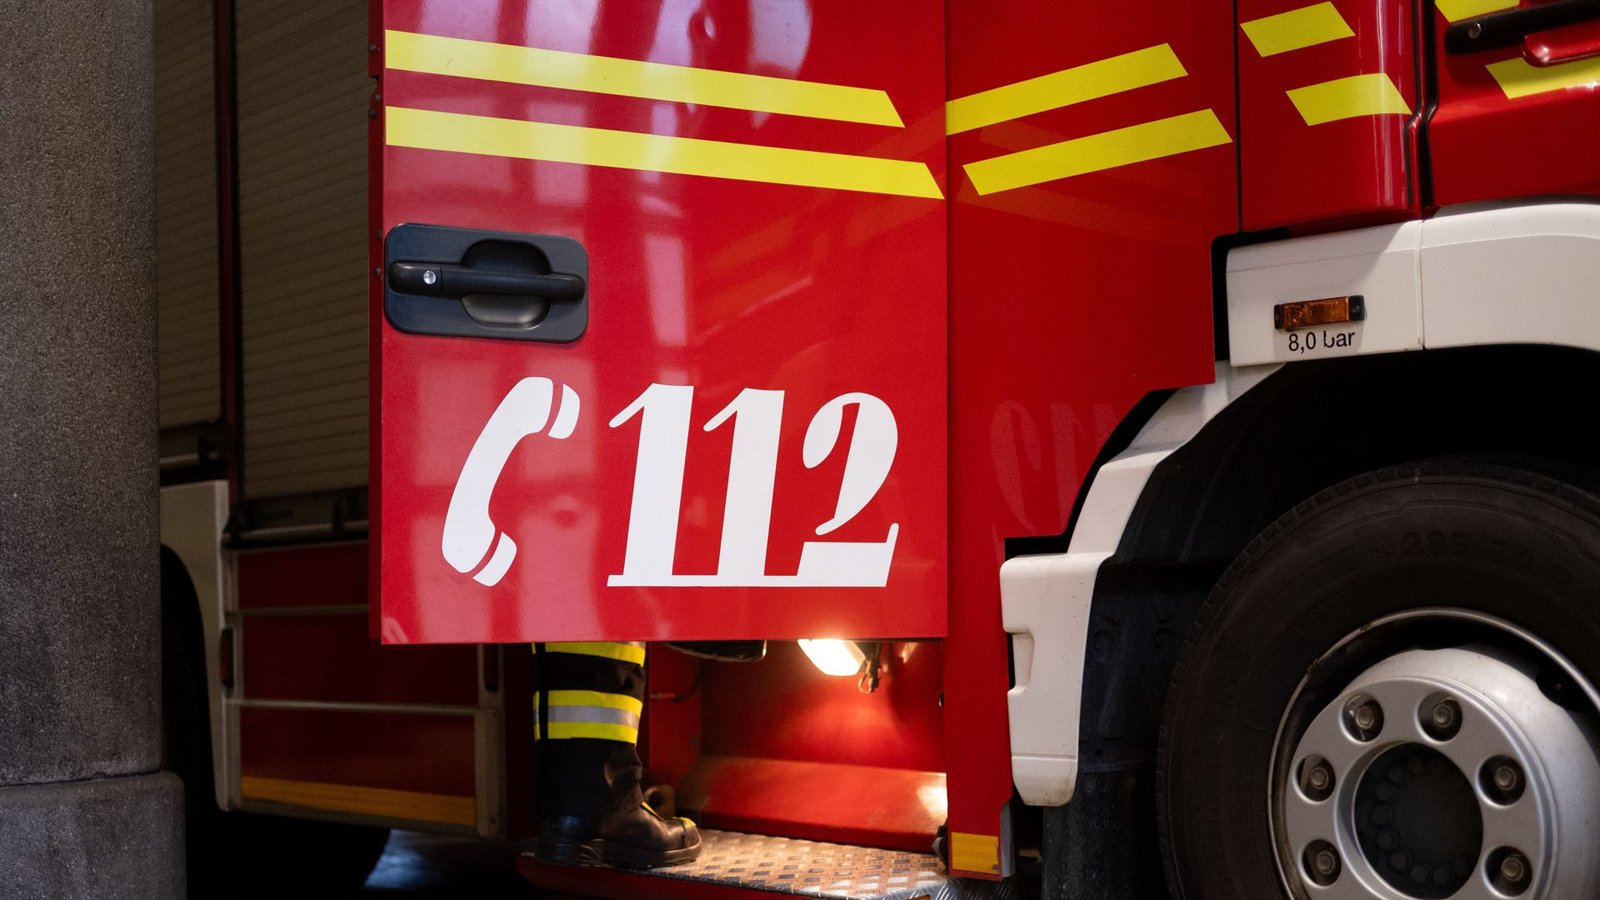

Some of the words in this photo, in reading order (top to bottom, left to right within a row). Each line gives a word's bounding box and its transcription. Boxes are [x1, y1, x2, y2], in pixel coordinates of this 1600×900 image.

[1289, 332, 1316, 353] 8,0
[1323, 330, 1355, 348] bar
[607, 383, 899, 588] 112
